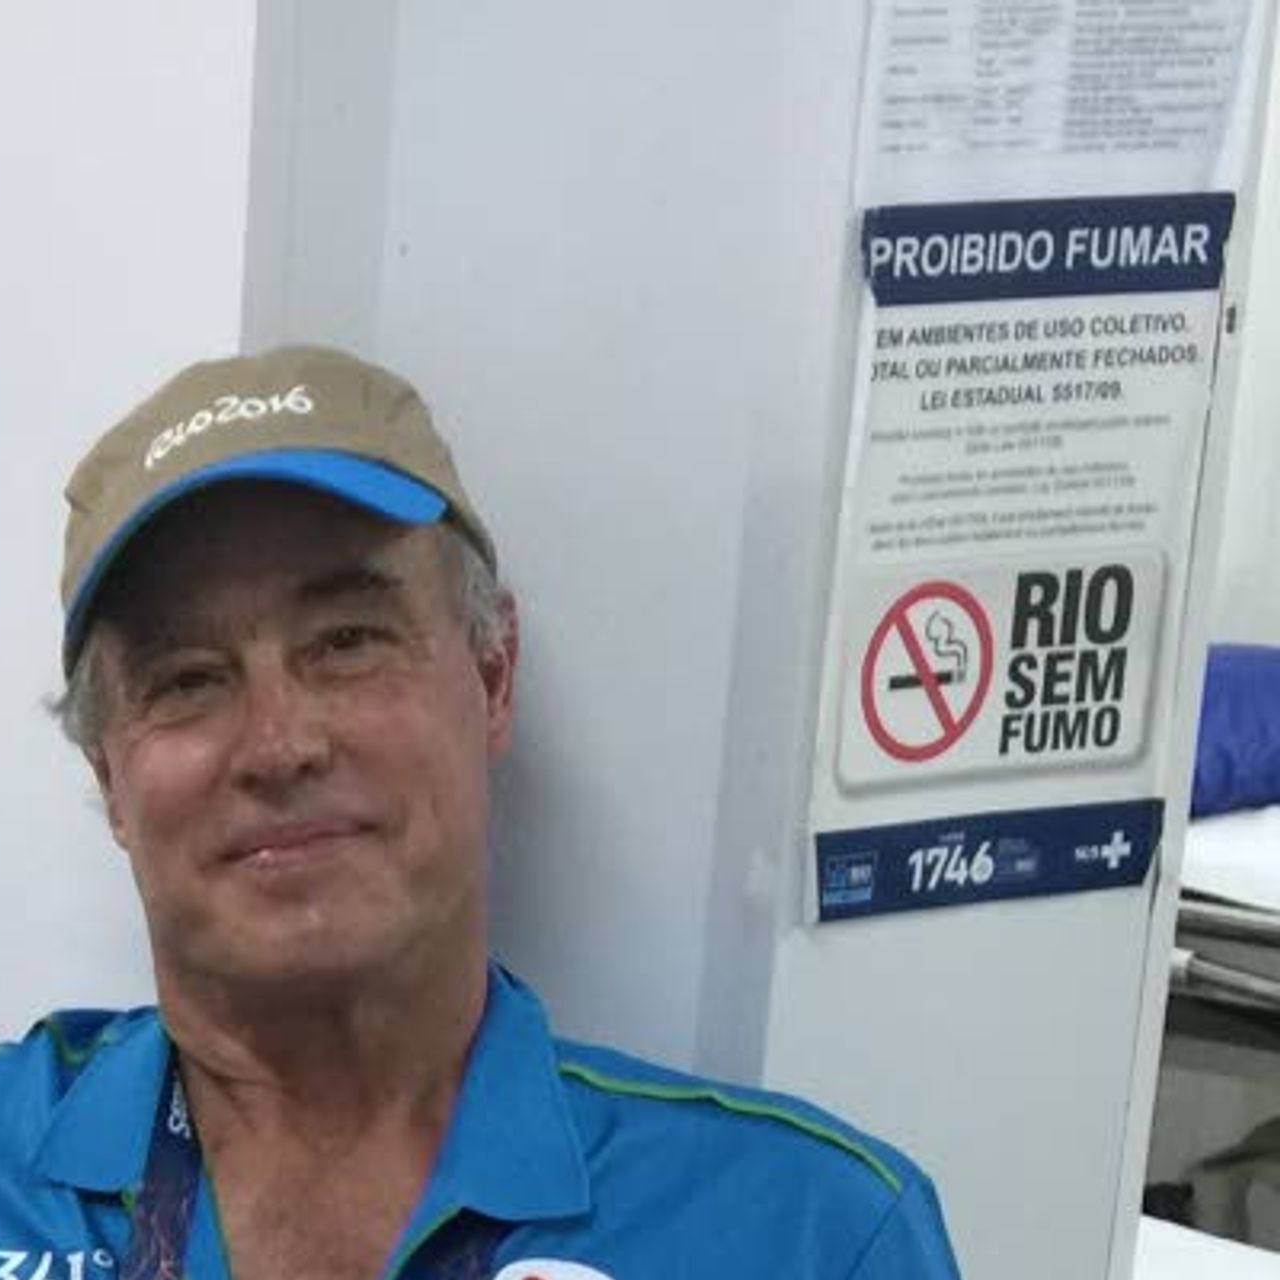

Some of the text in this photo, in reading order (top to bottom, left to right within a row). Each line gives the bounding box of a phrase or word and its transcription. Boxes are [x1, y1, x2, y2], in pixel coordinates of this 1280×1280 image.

[870, 223, 1210, 280] PROIBIDO FUMAR
[876, 327, 903, 349] EM
[907, 321, 1010, 348] AMBIENTES
[1014, 320, 1041, 341] DE
[1044, 317, 1085, 338] USO
[915, 355, 941, 378] OU
[945, 349, 1087, 377] PARCIALMENTE
[920, 391, 948, 411] LEI
[951, 384, 1043, 409] ESTADUAL
[144, 385, 314, 469] Rio2016
[1010, 563, 1134, 651] RIO
[1003, 647, 1128, 711] SEM
[998, 706, 1121, 757] FUMO
[907, 841, 995, 893] 1746
